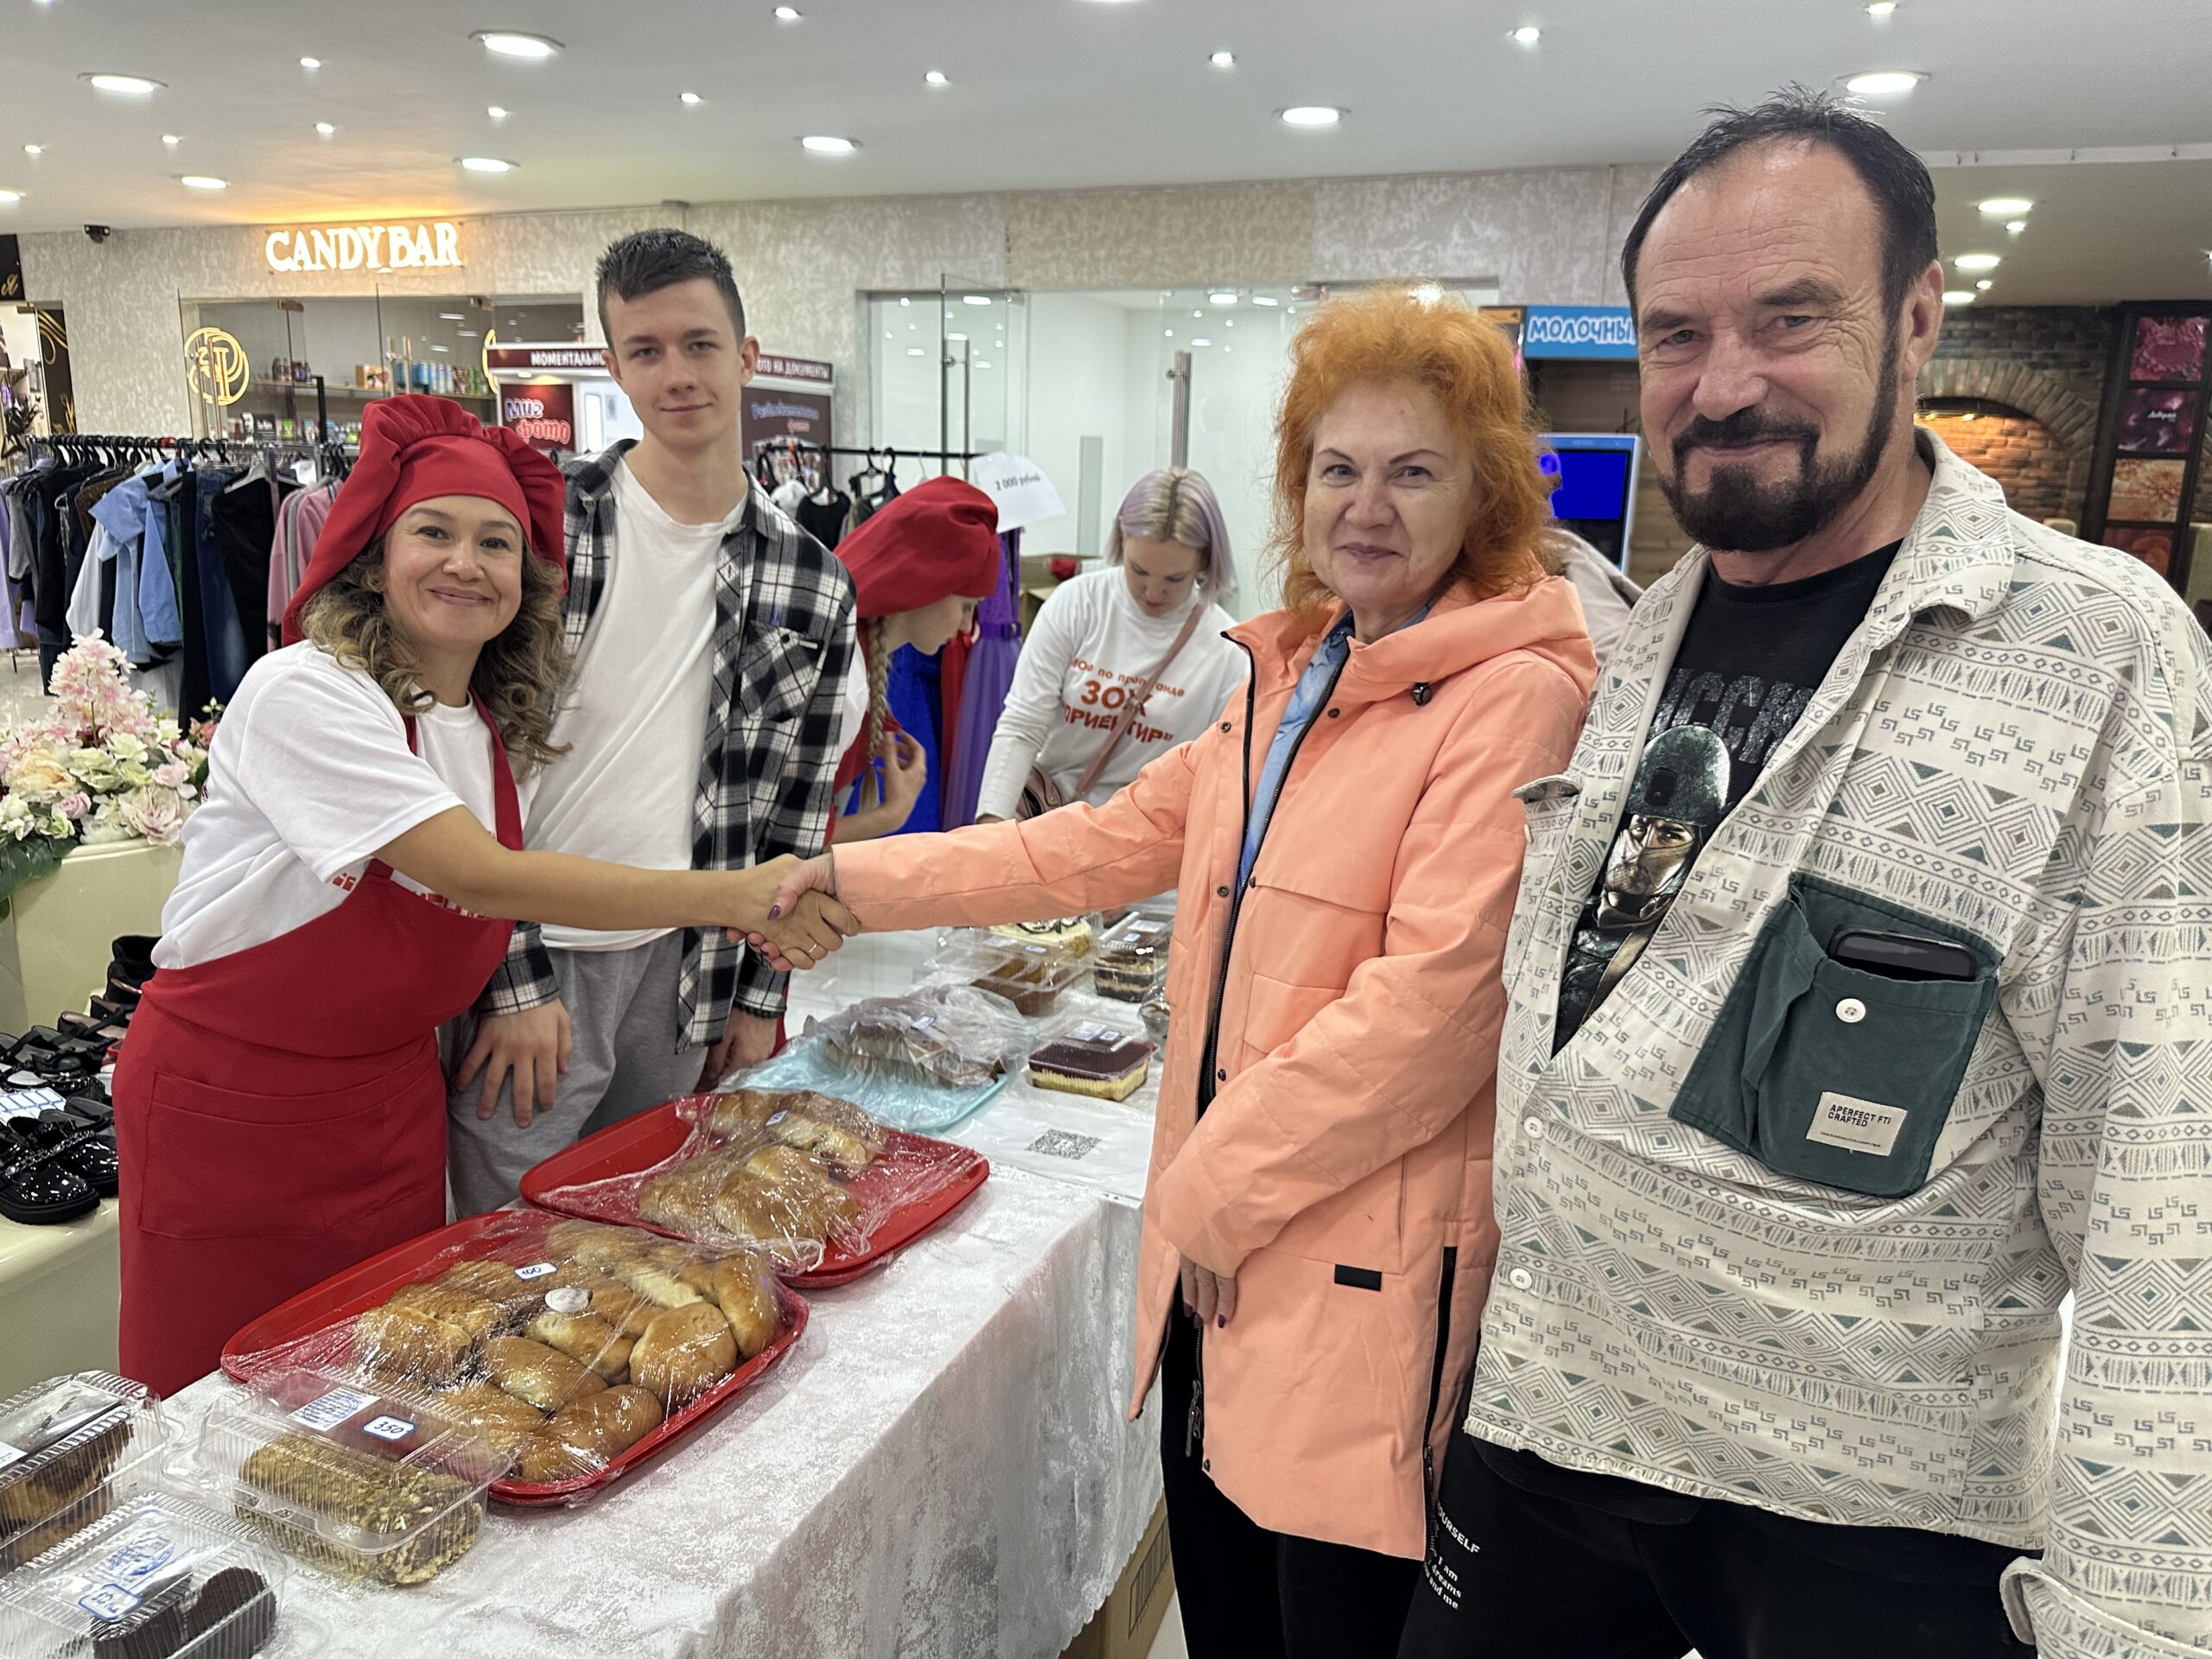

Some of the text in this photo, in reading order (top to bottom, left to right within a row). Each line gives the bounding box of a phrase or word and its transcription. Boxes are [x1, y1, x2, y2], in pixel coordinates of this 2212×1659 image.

[265, 221, 462, 272] CANDY BAR
[1527, 315, 1637, 345] МОЛОЧНЫ
[1098, 668, 1113, 679] по
[1827, 1111, 1868, 1128] CRAFTED
[374, 1421, 404, 1434] 350
[1432, 1564, 1462, 1598] dreams
[1443, 1565, 1459, 1582] am
[1429, 1576, 1459, 1609] and me
